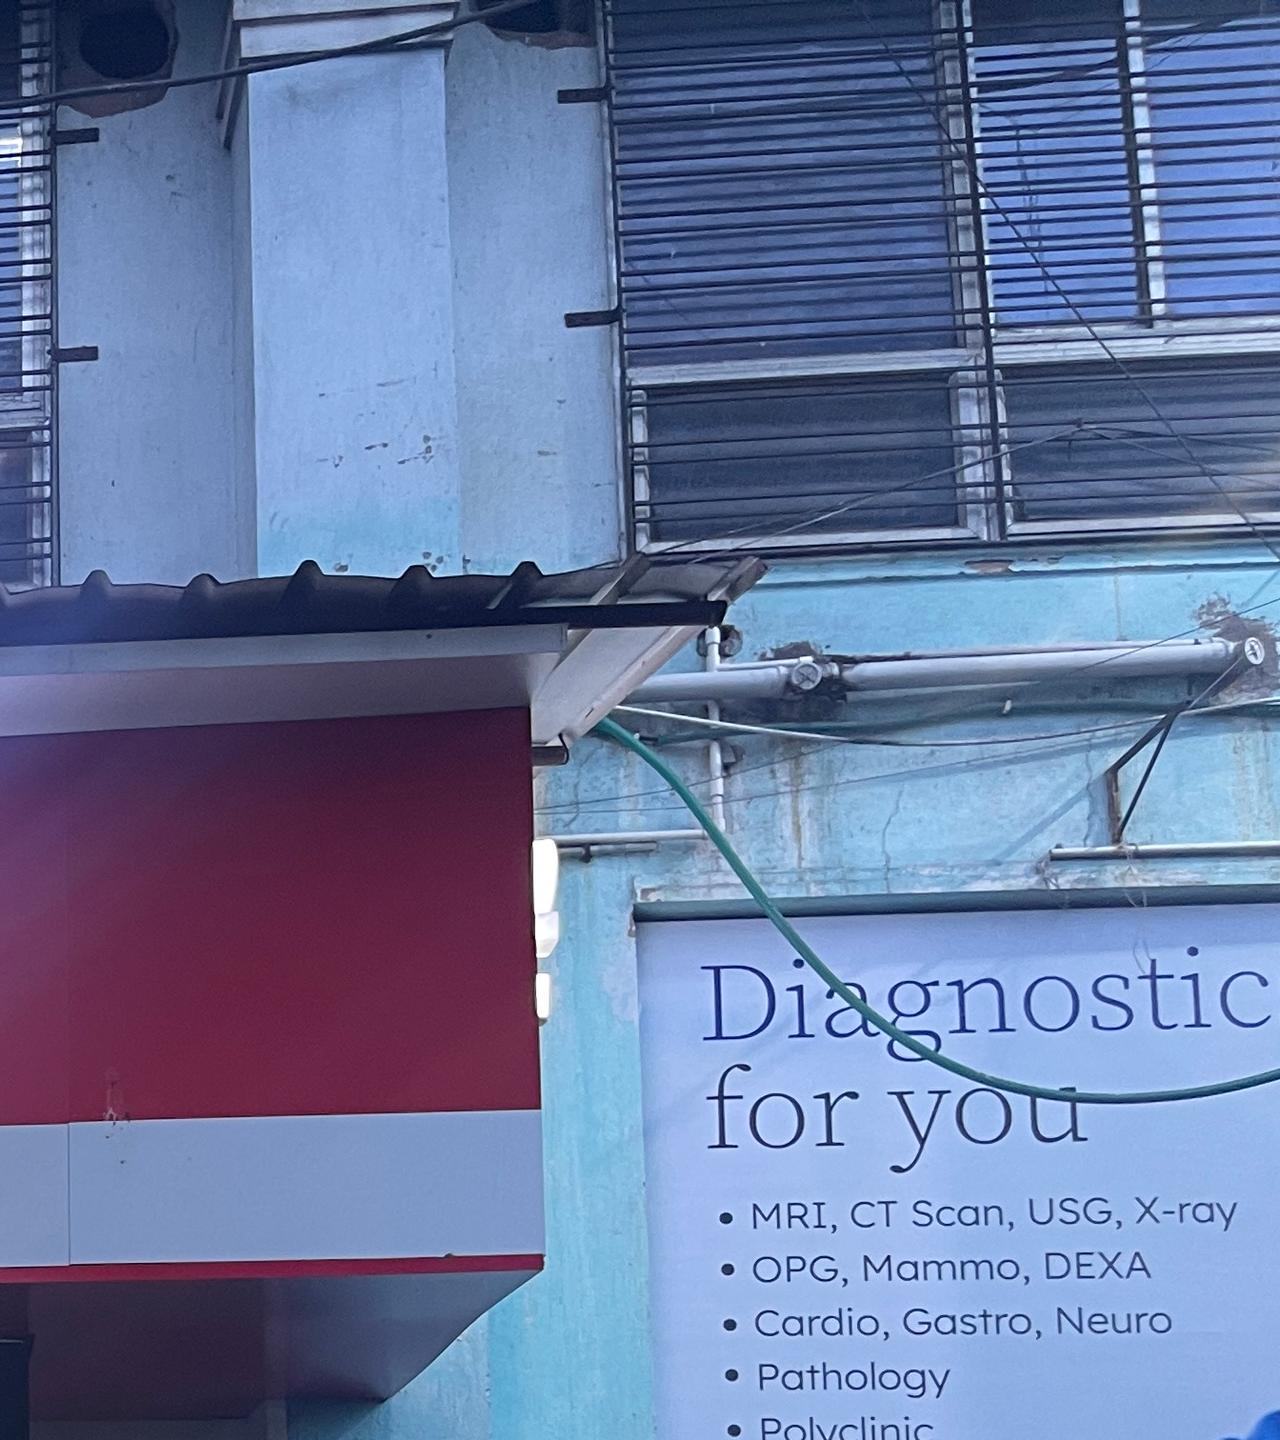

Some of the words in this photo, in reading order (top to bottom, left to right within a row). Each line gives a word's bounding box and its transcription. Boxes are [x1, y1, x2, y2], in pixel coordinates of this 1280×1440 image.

[700, 946, 1272, 1062] Diagnostic
[706, 1063, 859, 1150] for
[888, 1085, 1088, 1174] you
[751, 1200, 839, 1233] MRI,
[850, 1200, 897, 1229] CT
[912, 1200, 1015, 1231] Scan,
[1029, 1197, 1124, 1230] USG,
[1135, 1196, 1239, 1231] X-ray
[752, 1255, 849, 1288] OPG,
[862, 1252, 1031, 1286] Mammo,
[1045, 1251, 1152, 1281] DEXA
[754, 1307, 890, 1341] Cardio,
[902, 1307, 1042, 1339] Gastro,
[1057, 1306, 1173, 1336] Neuro
[757, 1362, 951, 1399] Pathology
